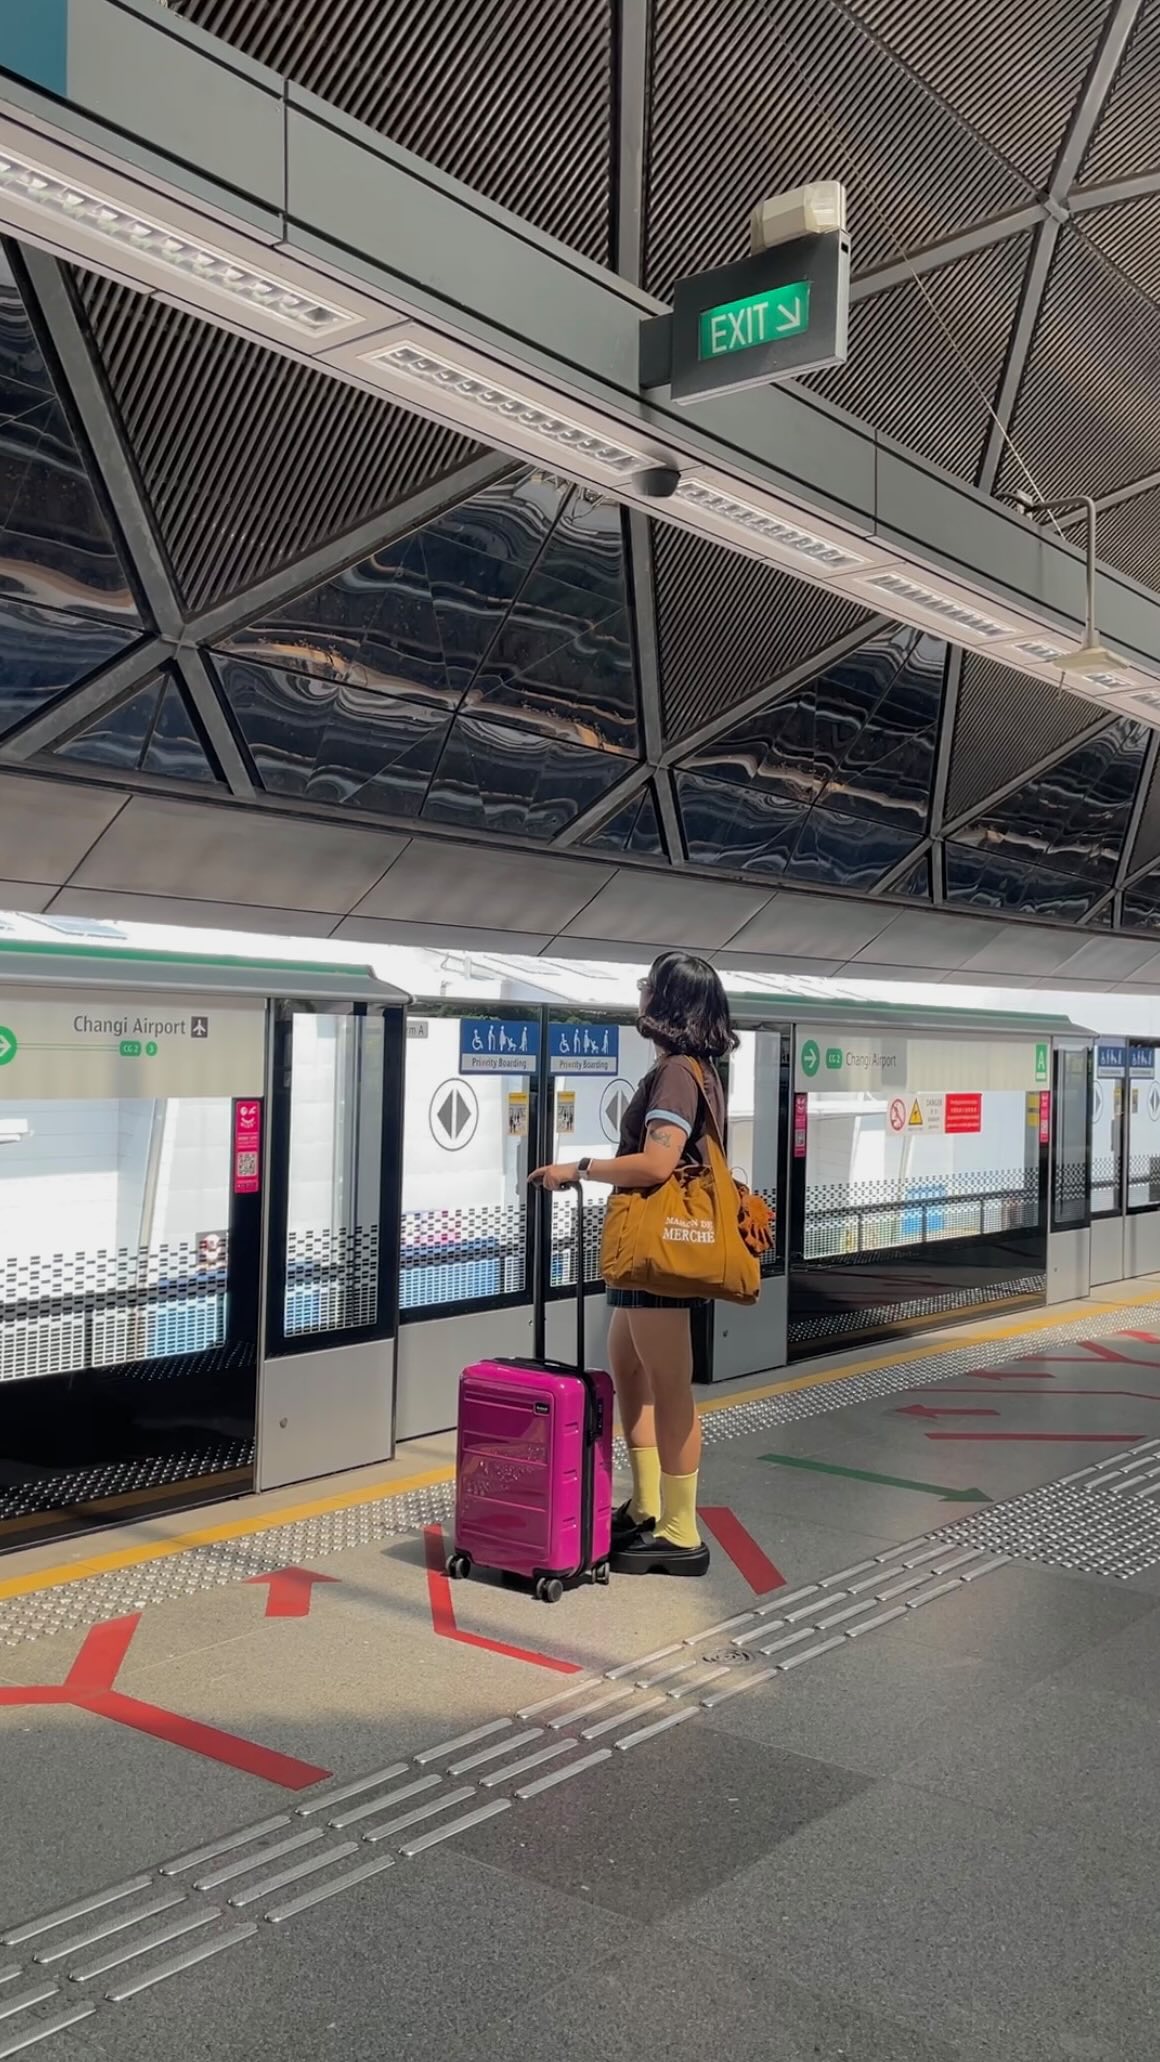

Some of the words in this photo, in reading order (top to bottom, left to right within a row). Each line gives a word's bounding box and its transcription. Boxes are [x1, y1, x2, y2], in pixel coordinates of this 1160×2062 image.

[711, 301, 769, 354] EXIT
[73, 1015, 128, 1037] Changi
[132, 1017, 186, 1038] Airport
[472, 1057, 497, 1069] Priority
[498, 1057, 527, 1070] Boarding
[560, 1060, 582, 1071] Priority
[583, 1059, 609, 1071] Boarding
[845, 1051, 871, 1070] Changi
[872, 1052, 897, 1069] Airport
[1037, 1049, 1045, 1072] A
[662, 1227, 716, 1243] MERCHE
